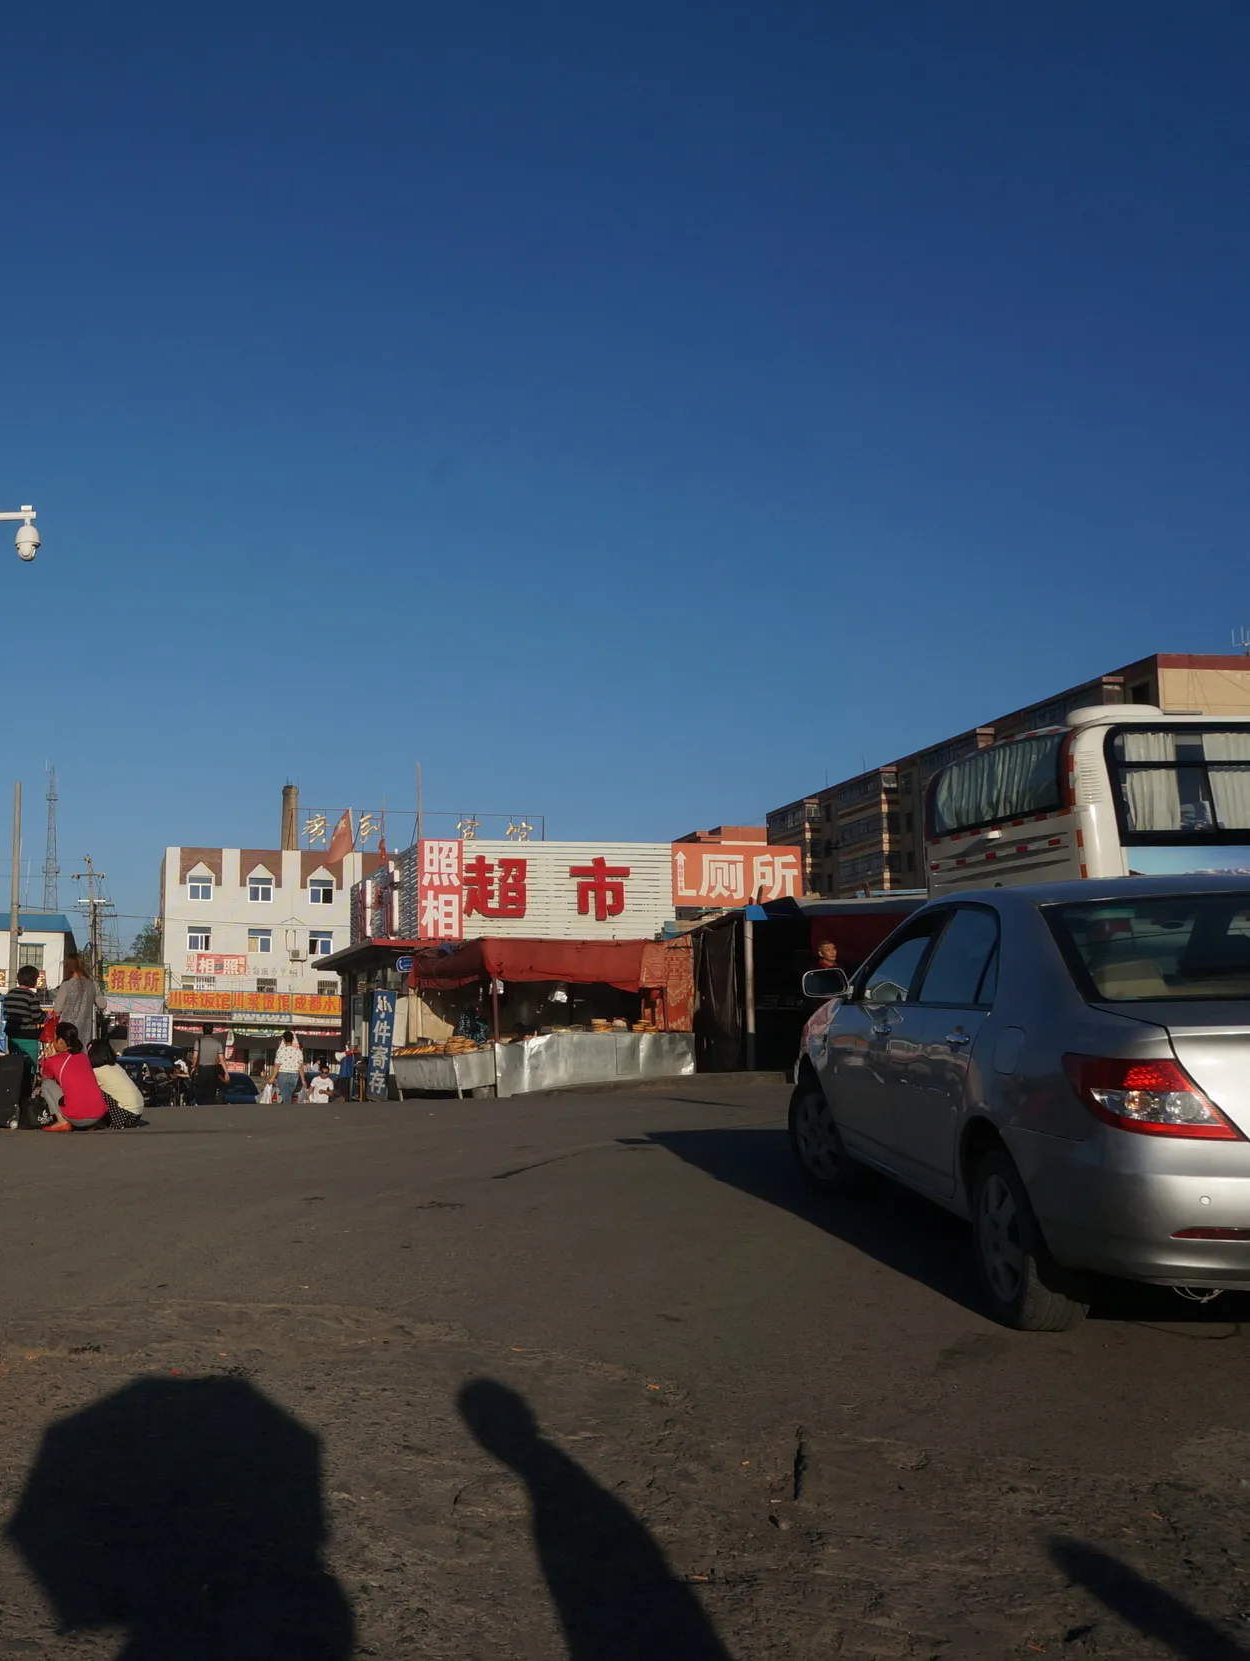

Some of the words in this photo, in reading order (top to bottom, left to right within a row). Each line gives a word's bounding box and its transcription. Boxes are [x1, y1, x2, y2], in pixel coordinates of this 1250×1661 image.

[421, 840, 461, 938] 照相
[463, 855, 631, 921] 超市
[698, 853, 798, 900] 厕所
[111, 969, 159, 992] 招待所
[168, 991, 230, 1009] 川味饭馆
[294, 995, 342, 1012] 成都小
[368, 995, 394, 1095] 小件寄存
